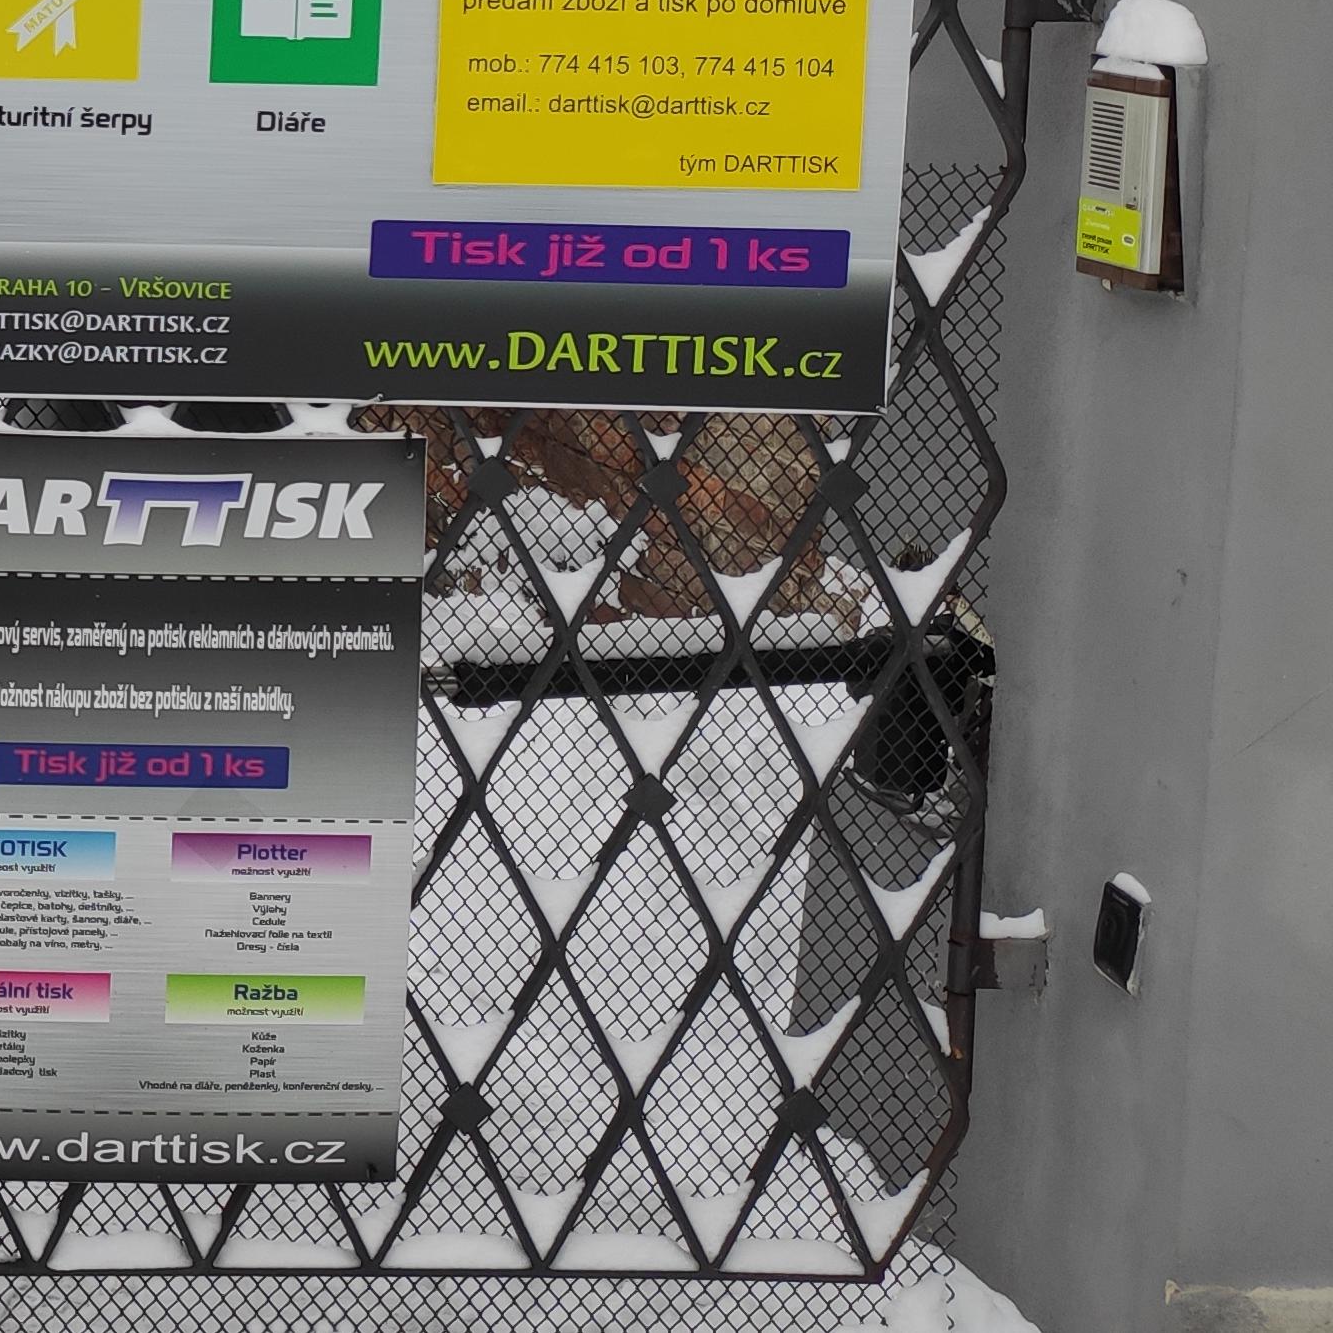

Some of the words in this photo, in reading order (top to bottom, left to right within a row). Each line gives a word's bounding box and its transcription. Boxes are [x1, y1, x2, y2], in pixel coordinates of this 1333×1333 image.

[468, 54, 530, 74] mob.:
[539, 55, 580, 74] 774
[588, 56, 630, 74] 415
[641, 56, 686, 79] 103,
[695, 57, 736, 76] 774
[743, 58, 785, 77] 415
[795, 58, 834, 77] 104
[467, 93, 540, 113] email.:
[548, 94, 771, 119] darttisk@darttisk.cz
[79, 107, 153, 136] šerpy
[256, 108, 326, 135] Diáře
[679, 155, 716, 175] tým
[724, 155, 839, 174] DARTTISK
[412, 231, 526, 265] Tisk
[540, 235, 605, 276] již
[624, 238, 691, 270] od
[710, 240, 727, 270] 1
[748, 240, 810, 272] ks
[65, 280, 93, 297] 10
[23, 621, 64, 651] servis,
[67, 622, 127, 656] zaměřený
[130, 629, 145, 647] na
[148, 623, 186, 656] potisk
[189, 624, 254, 650] reklamních
[257, 632, 264, 649] a
[268, 625, 330, 658] dárkových
[334, 624, 394, 658] předmětů.
[46, 683, 91, 717] nákupu
[94, 684, 129, 709] zboží
[130, 685, 153, 709] bez
[156, 685, 201, 717] potisku
[204, 692, 211, 710] z
[215, 686, 242, 711] naší
[243, 686, 294, 719] nabídky.
[14, 749, 88, 775] Tisk
[95, 750, 138, 783] již
[148, 752, 192, 777] od
[200, 754, 214, 777] 1
[224, 754, 265, 779] ks
[238, 844, 307, 860] Plotter
[250, 892, 291, 903] Bannery
[36, 983, 73, 999] tisk
[234, 984, 298, 1001] Ražba
[252, 1031, 277, 1041] Kůže
[242, 1045, 284, 1054] Koženka
[250, 1057, 276, 1067] Papír
[39, 1068, 57, 1077] tisk
[250, 1069, 276, 1078] Plast
[139, 1081, 177, 1090] Vhodné
